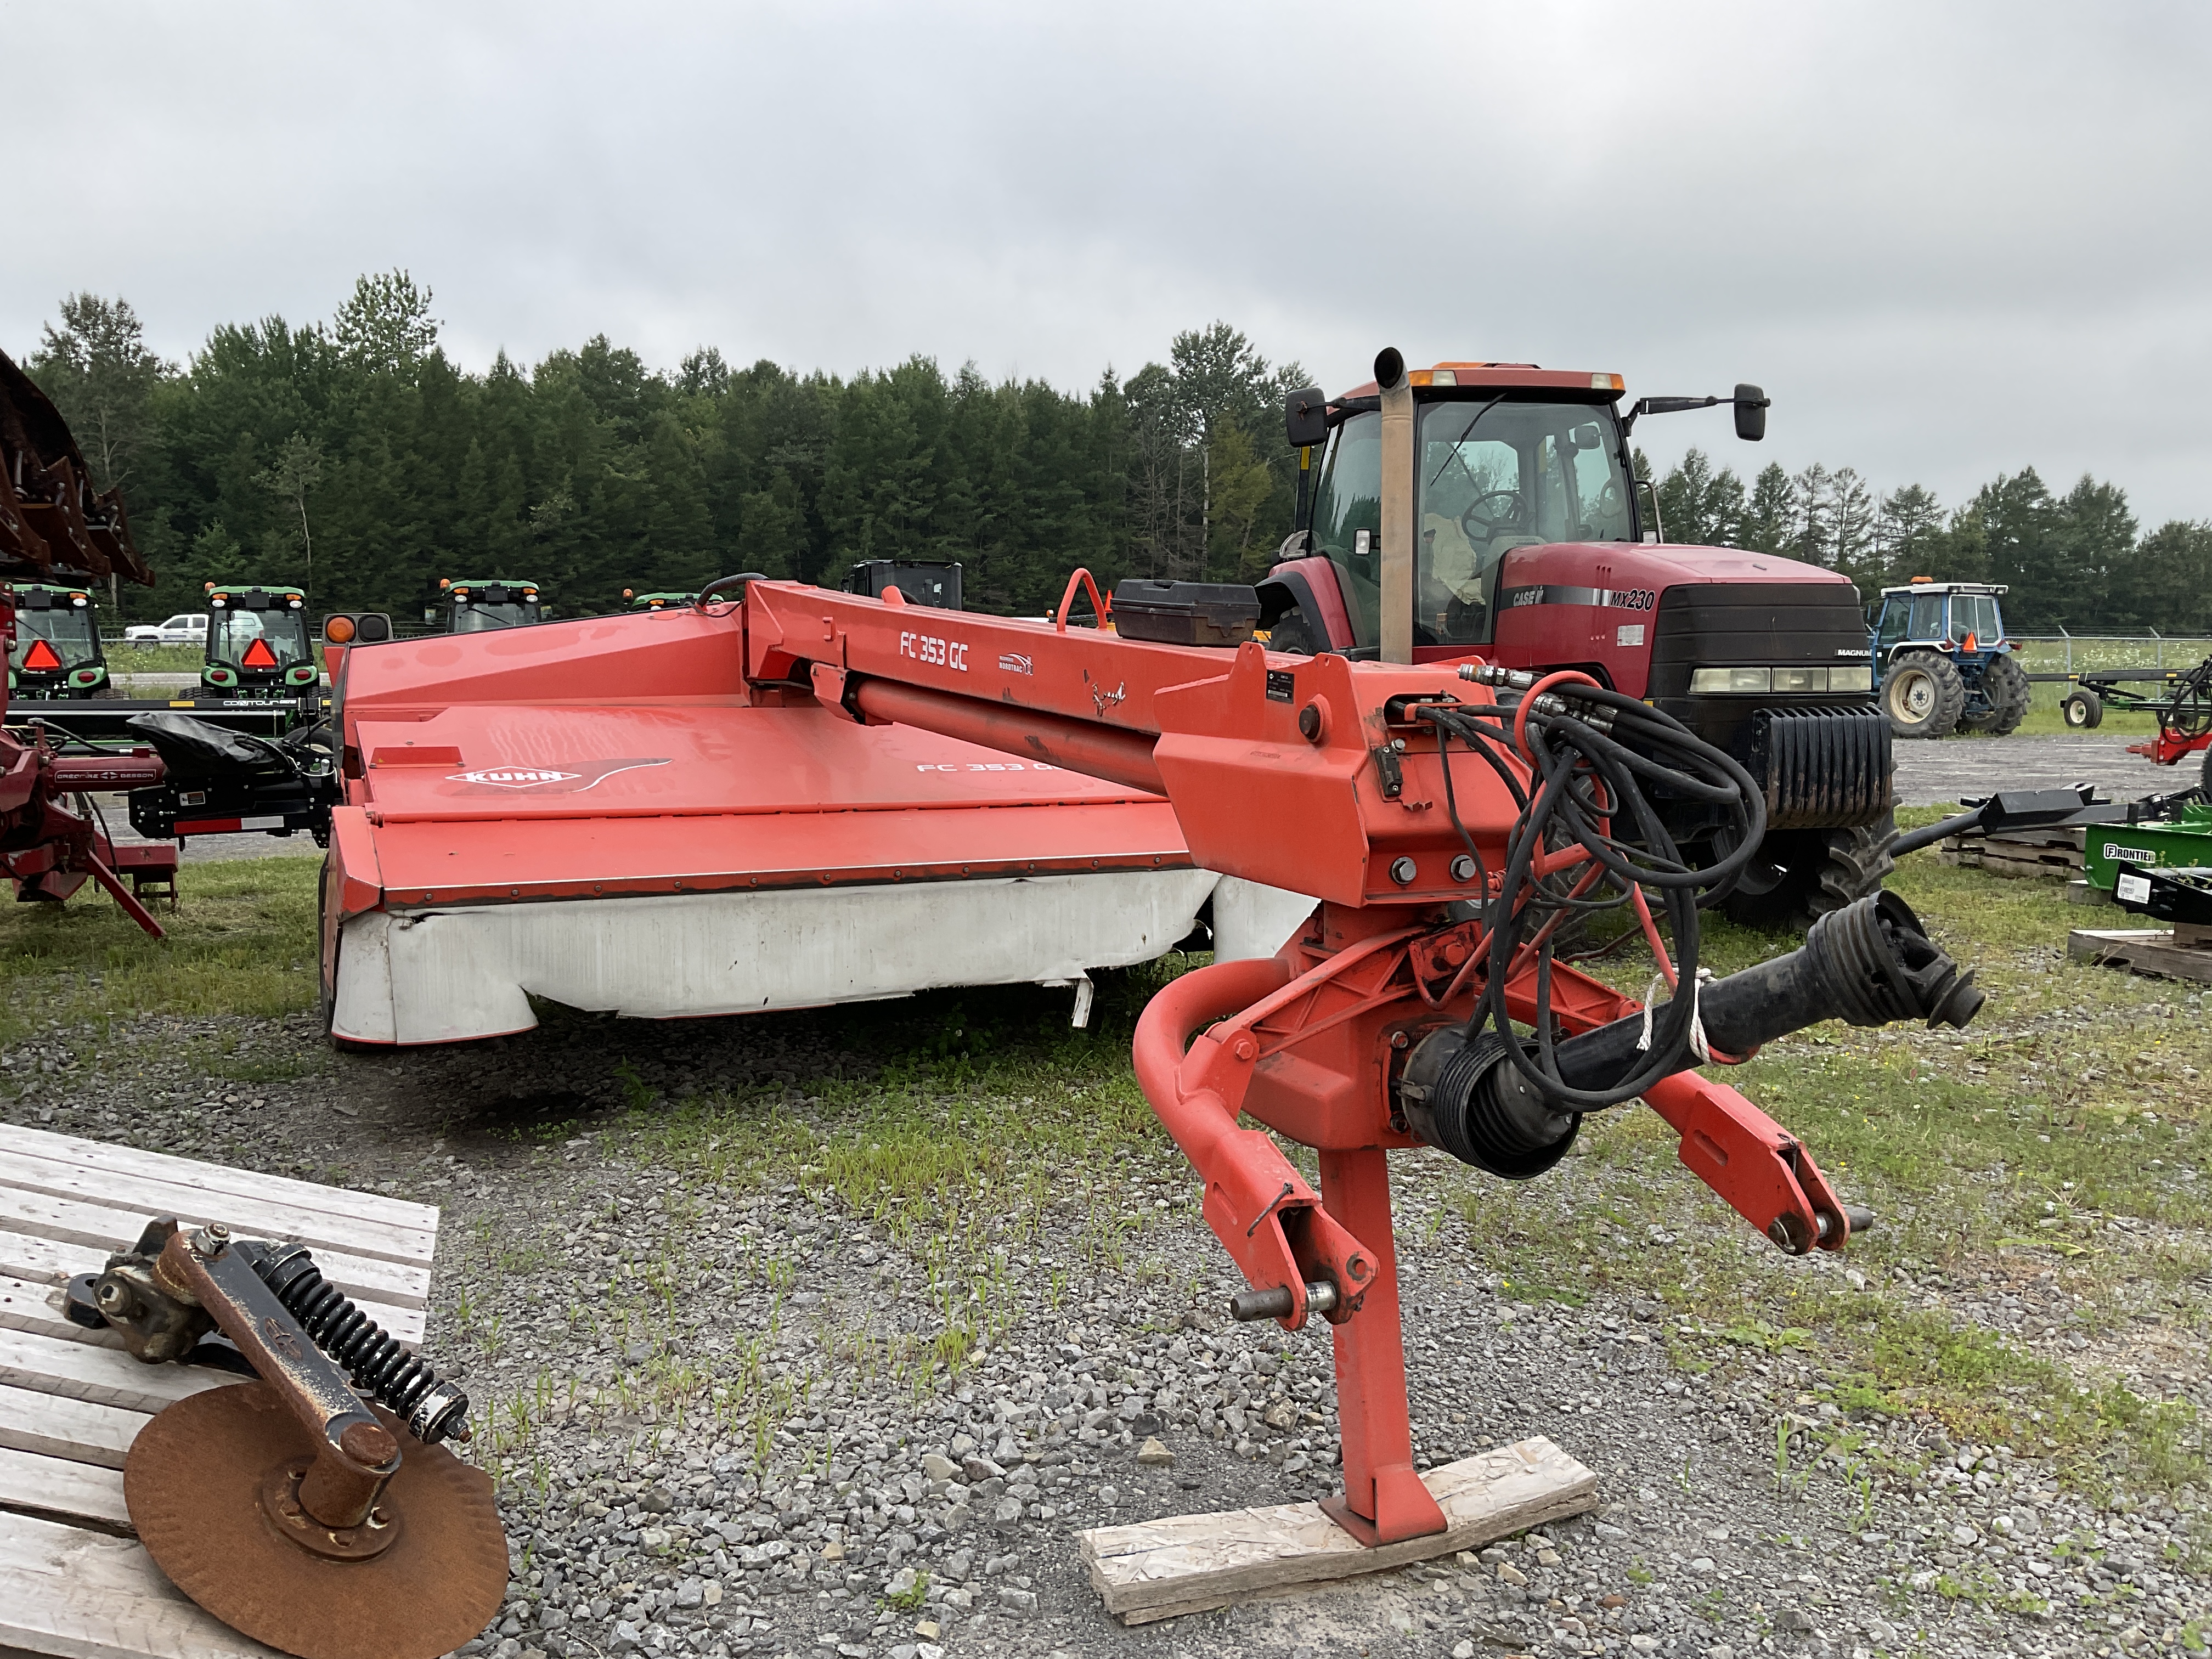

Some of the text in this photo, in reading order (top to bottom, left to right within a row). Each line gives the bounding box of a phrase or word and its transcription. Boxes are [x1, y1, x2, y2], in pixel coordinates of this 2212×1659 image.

[1513, 591, 1535, 607] CASE
[1610, 589, 1655, 612] MX230
[900, 631, 968, 671] FC 353 GC
[999, 662, 1023, 673] NORDTRAC
[466, 772, 562, 782] KUHN
